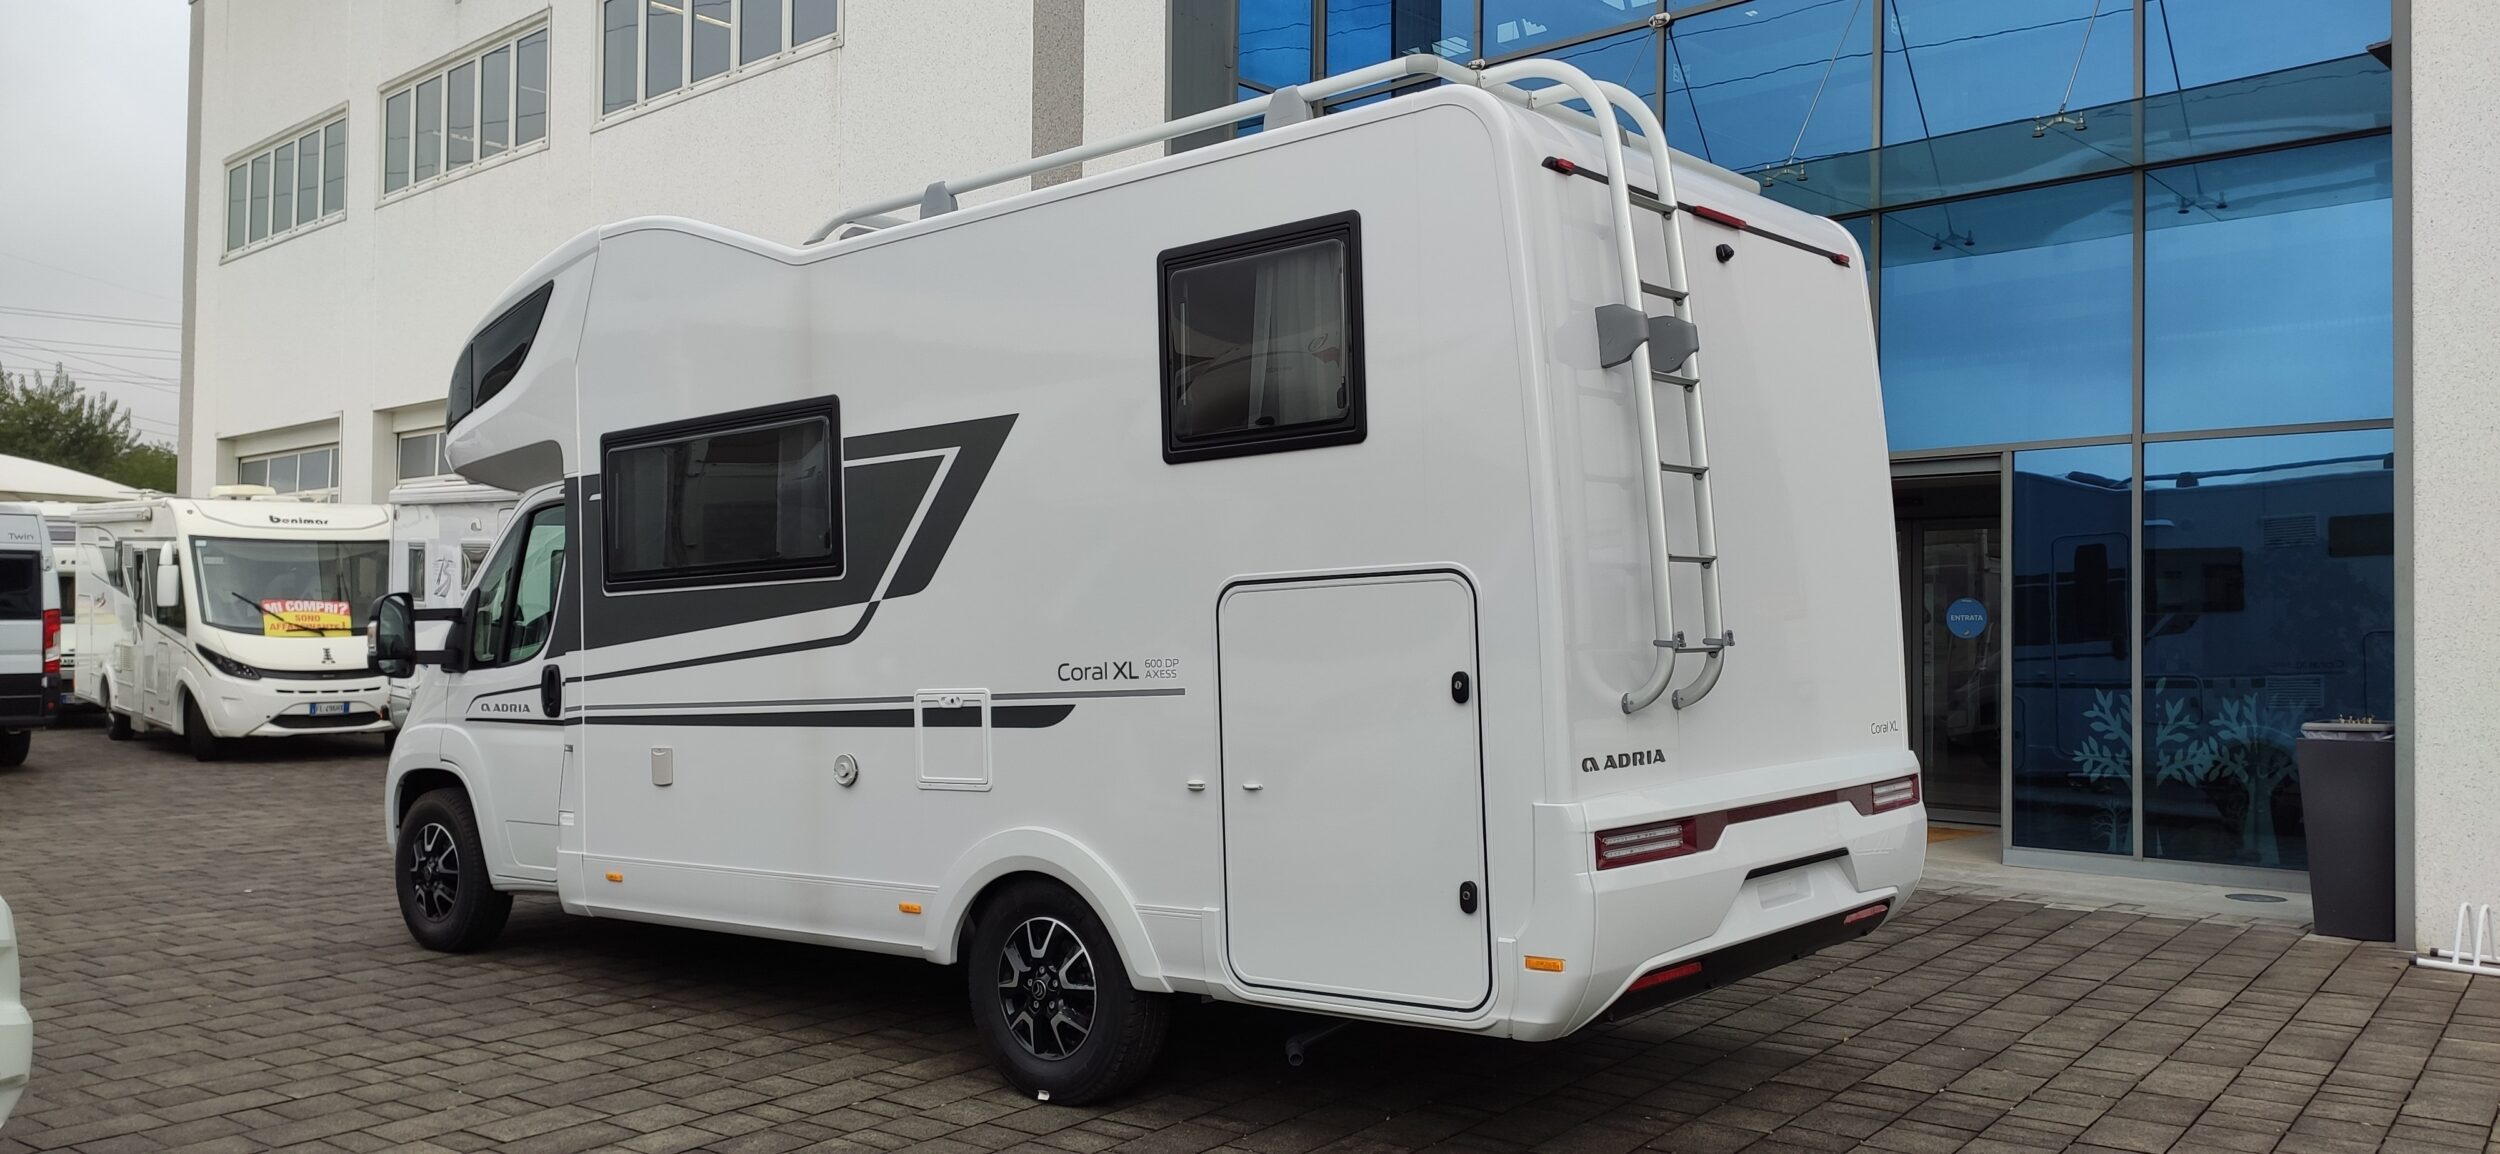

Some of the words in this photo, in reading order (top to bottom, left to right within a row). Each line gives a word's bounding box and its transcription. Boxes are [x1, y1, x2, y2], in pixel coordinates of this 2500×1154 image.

[8, 532, 34, 541] Twin
[264, 601, 283, 613] MI
[285, 600, 350, 614] COMPRI?
[295, 614, 321, 622] SONO
[1951, 614, 1983, 622] ENTRATA
[1144, 658, 1163, 669] 600
[1165, 658, 1180, 668] DP
[1057, 661, 1108, 681] Coral
[1113, 661, 1140, 680] XL
[1144, 669, 1177, 679] AXESS
[493, 703, 531, 713] ADRIA
[1870, 721, 1889, 735] Coral
[1889, 720, 1899, 732] XL
[1603, 749, 1666, 771] ADRIA
